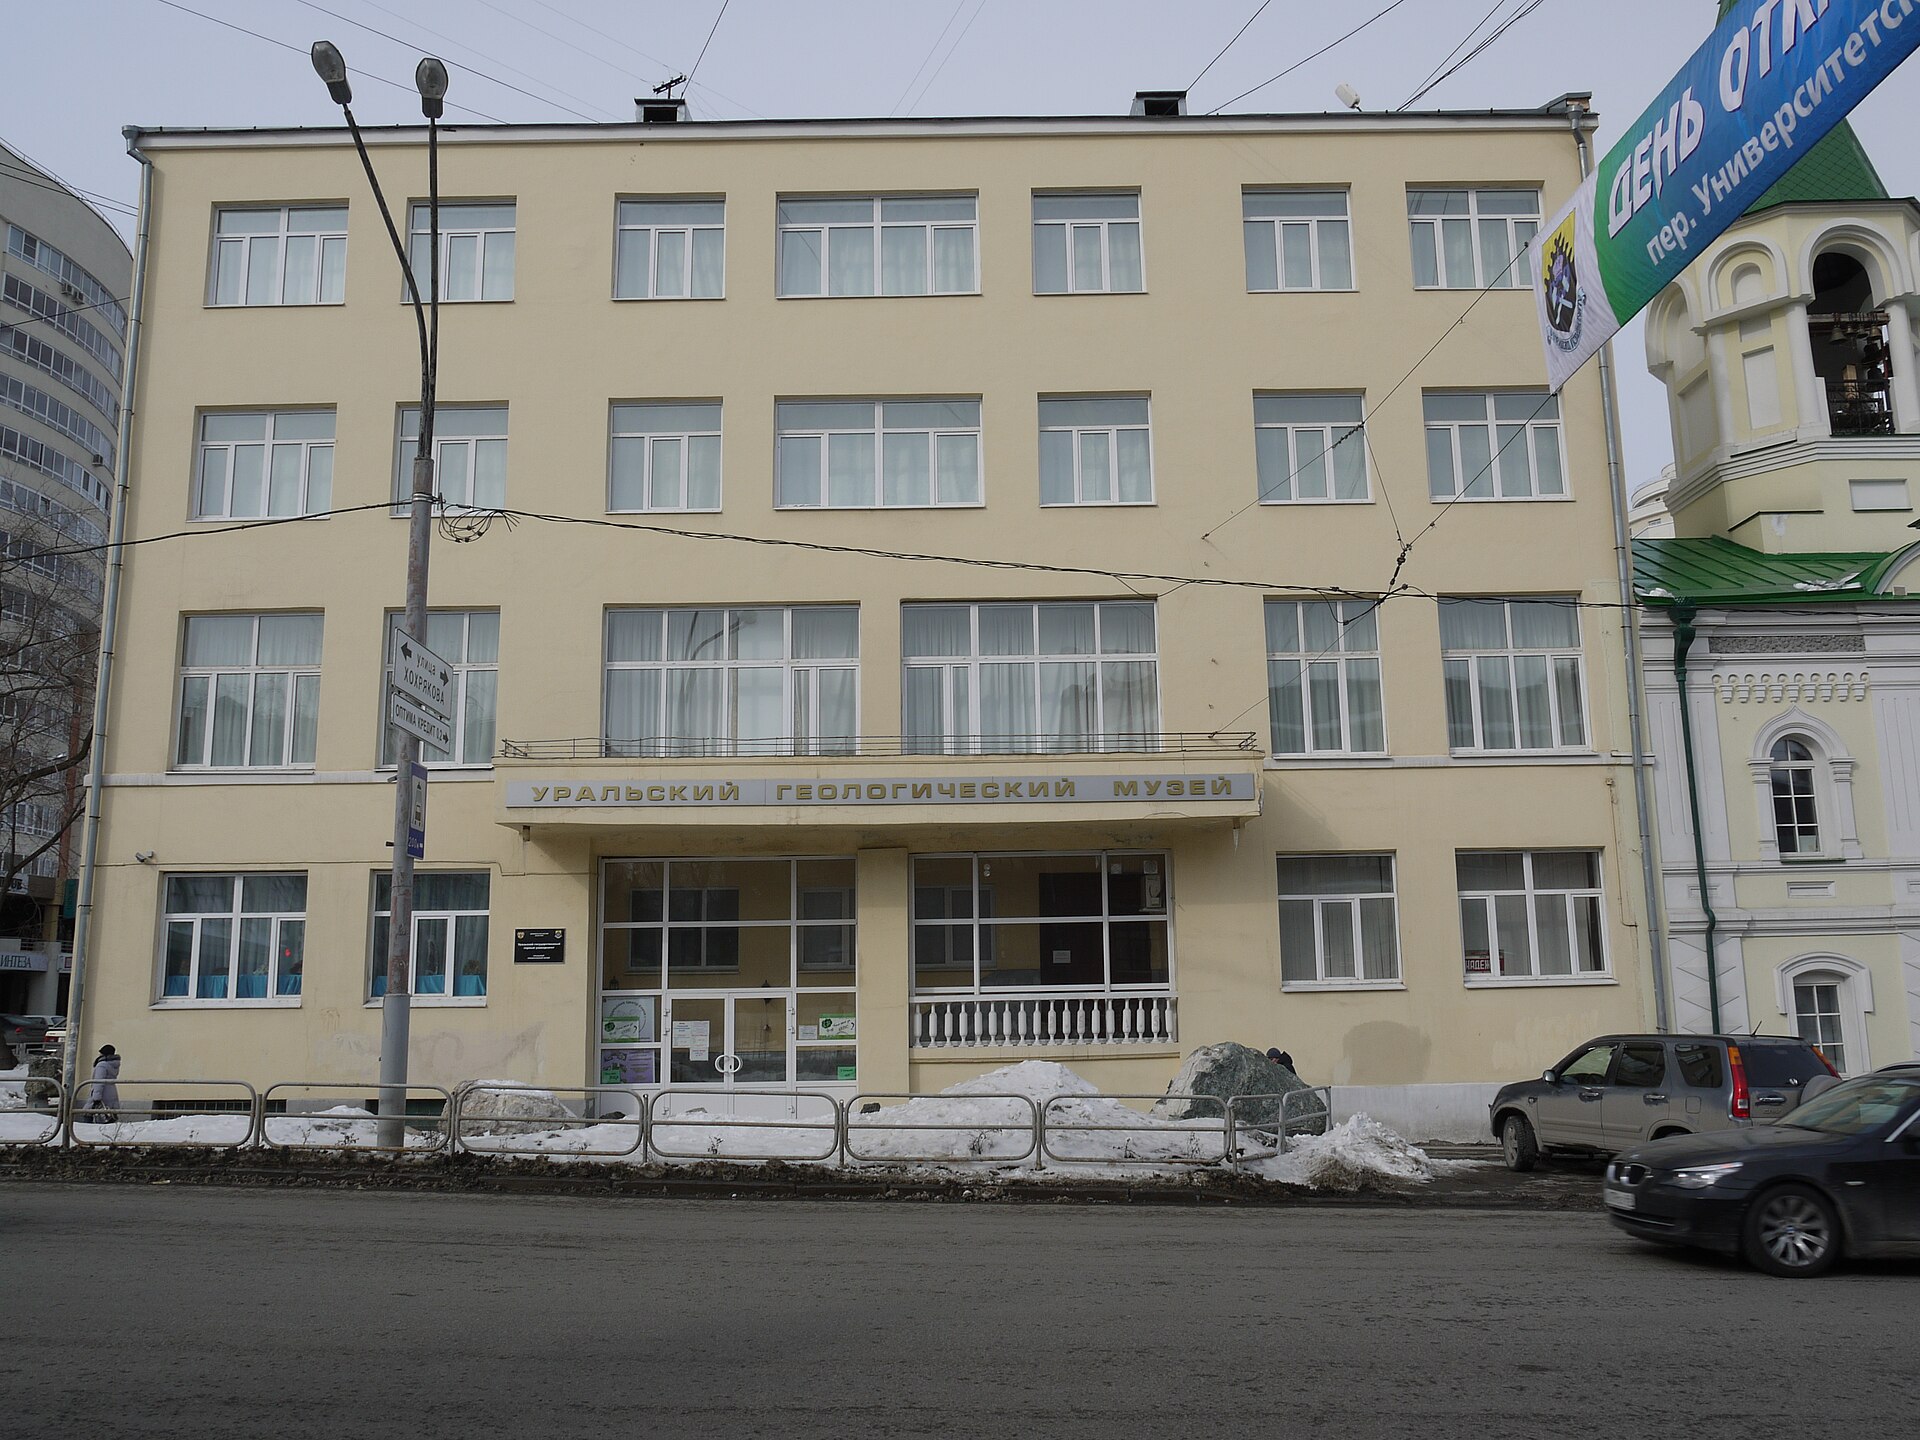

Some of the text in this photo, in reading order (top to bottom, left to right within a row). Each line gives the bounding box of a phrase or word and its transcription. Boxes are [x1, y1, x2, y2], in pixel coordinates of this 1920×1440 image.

[1608, 0, 1829, 240] ДЕНЬ ОТК
[1646, 211, 1697, 266] пер.
[417, 653, 436, 676] улица
[404, 666, 445, 705] ХОХРЯКОВА
[396, 704, 416, 727] ОПТИМА
[418, 717, 436, 738] КРЕДИТ
[531, 776, 1232, 802] УРАЛЬСКИЙ ГЕОЛОГИЧЕСКИЙ МУЗЕЙ
